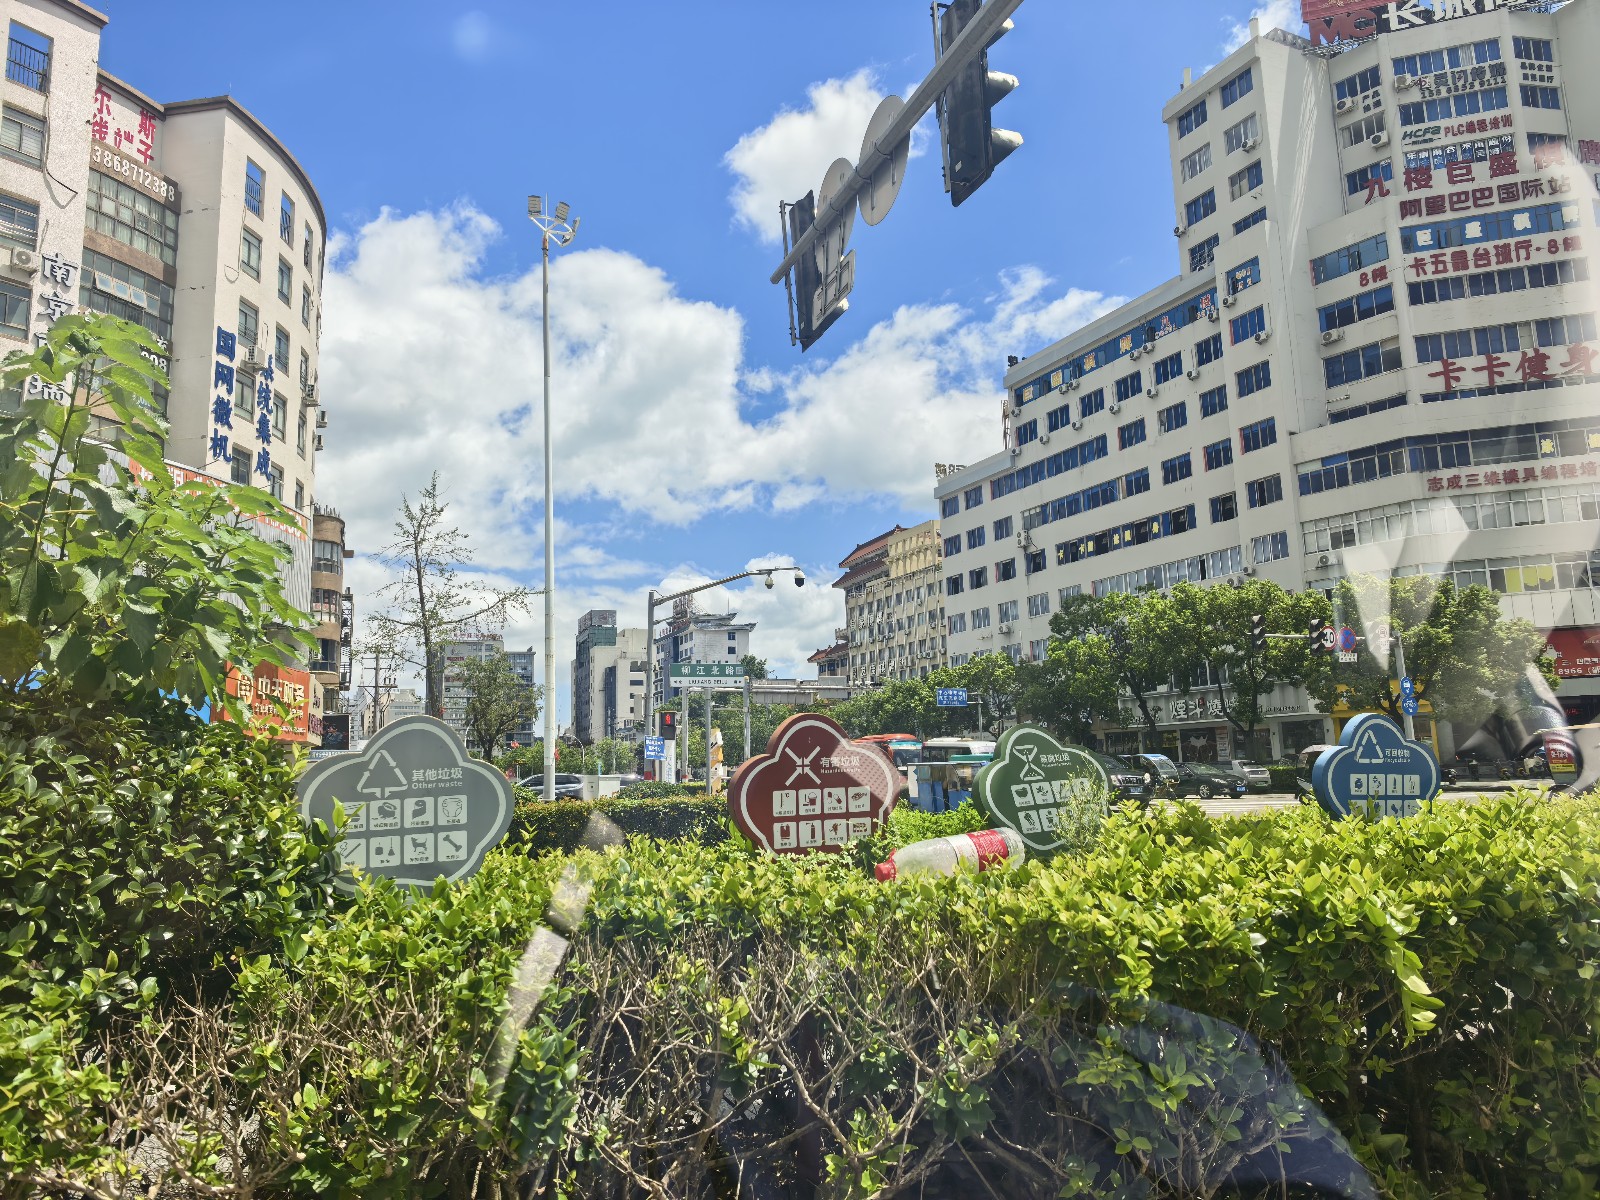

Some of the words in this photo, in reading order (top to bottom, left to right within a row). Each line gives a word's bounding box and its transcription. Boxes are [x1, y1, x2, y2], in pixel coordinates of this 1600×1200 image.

[820, 756, 860, 768] 有害垃圾
[411, 767, 463, 781] 其他垃圾
[411, 781, 437, 790] Other
[438, 780, 463, 788] waste
